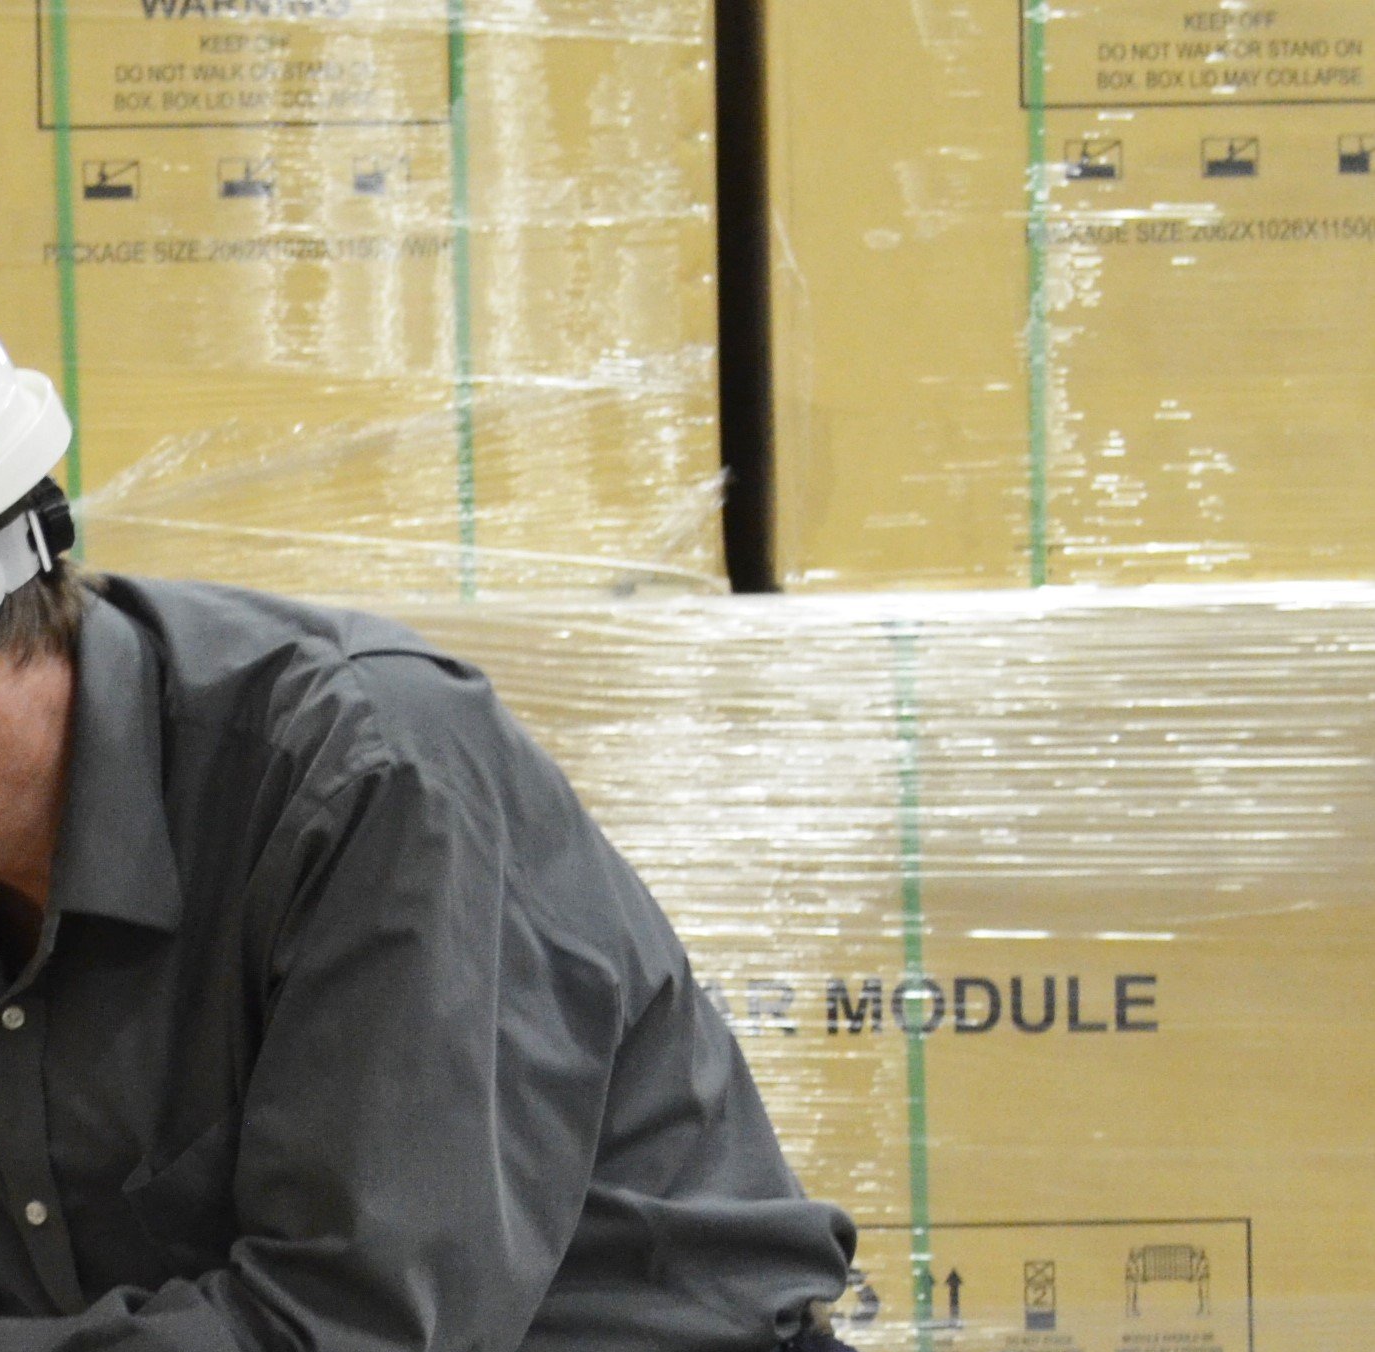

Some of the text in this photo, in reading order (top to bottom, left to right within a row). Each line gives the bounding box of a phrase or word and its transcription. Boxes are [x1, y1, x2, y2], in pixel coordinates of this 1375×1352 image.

[1183, 9, 1277, 31] KEEP OFF
[199, 34, 248, 53] KEEP
[1098, 42, 1126, 61] DO
[1131, 41, 1170, 60] NOT
[1234, 39, 1261, 58] OR
[1268, 38, 1330, 58] STAND
[1335, 37, 1363, 57] ON
[115, 64, 144, 83] DO
[147, 63, 186, 82] NOT
[192, 63, 243, 82] WALK
[1146, 70, 1183, 89] BOX
[1189, 69, 1218, 88] LID
[1223, 68, 1262, 87] MAY
[1265, 66, 1363, 87] COLLAPSE
[162, 92, 201, 111] BOX
[205, 91, 234, 109] LID
[827, 974, 1159, 1036] MODULE
